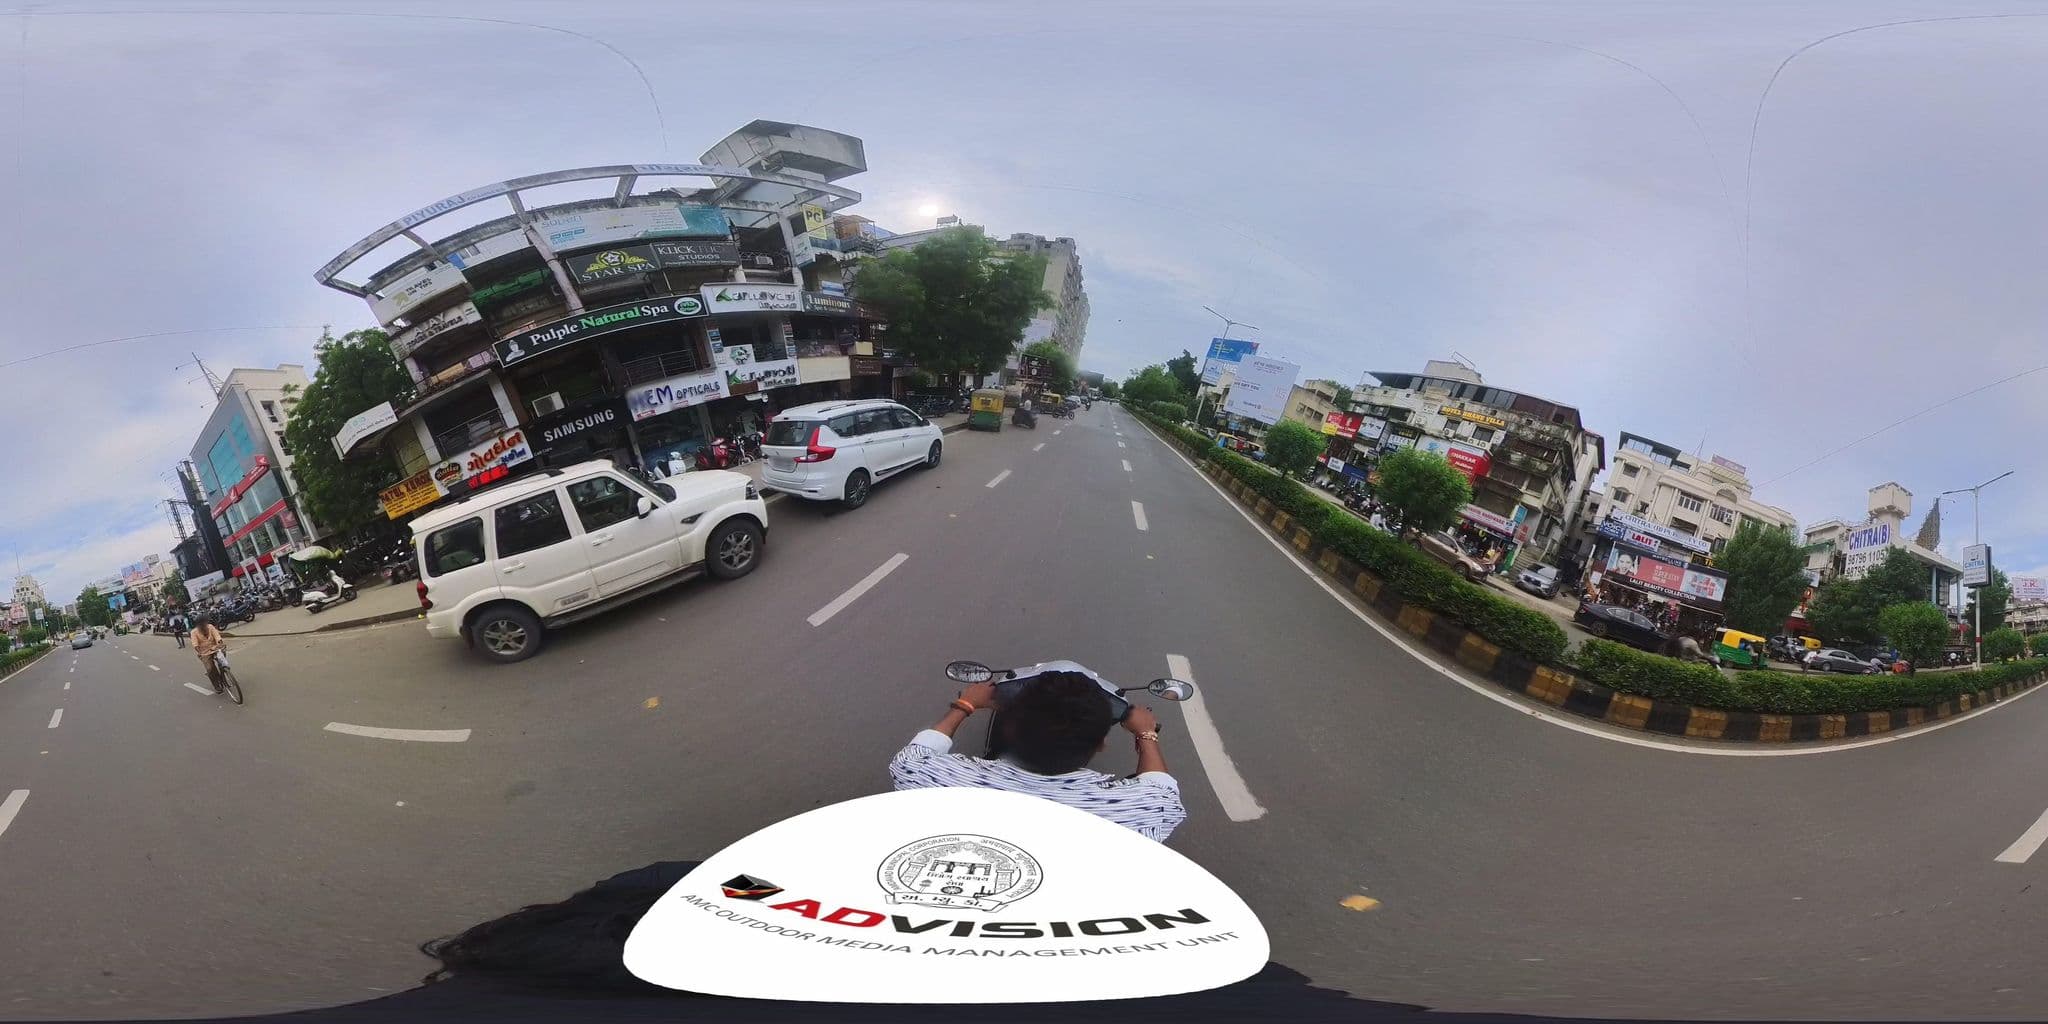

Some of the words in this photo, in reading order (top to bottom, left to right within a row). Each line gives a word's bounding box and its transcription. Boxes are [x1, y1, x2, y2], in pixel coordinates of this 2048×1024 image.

[403, 195, 465, 226] PIYURAJ
[806, 210, 822, 223] PG
[657, 246, 697, 255] KLICK
[678, 253, 720, 261] STUDIOS
[581, 266, 624, 282] STAR
[627, 261, 655, 273] SPA
[529, 320, 579, 347] Pulple
[579, 306, 642, 331] Natural
[640, 303, 669, 318] Spa
[676, 381, 721, 399] OPTICALS
[543, 408, 615, 442] SAMSUNG
[1631, 532, 1654, 546] LALIT
[1846, 551, 1867, 566] 98796
[1629, 577, 1644, 587] LALIT
[1643, 581, 1665, 593] BEAUTY
[1664, 585, 1697, 601] COLLECTION
